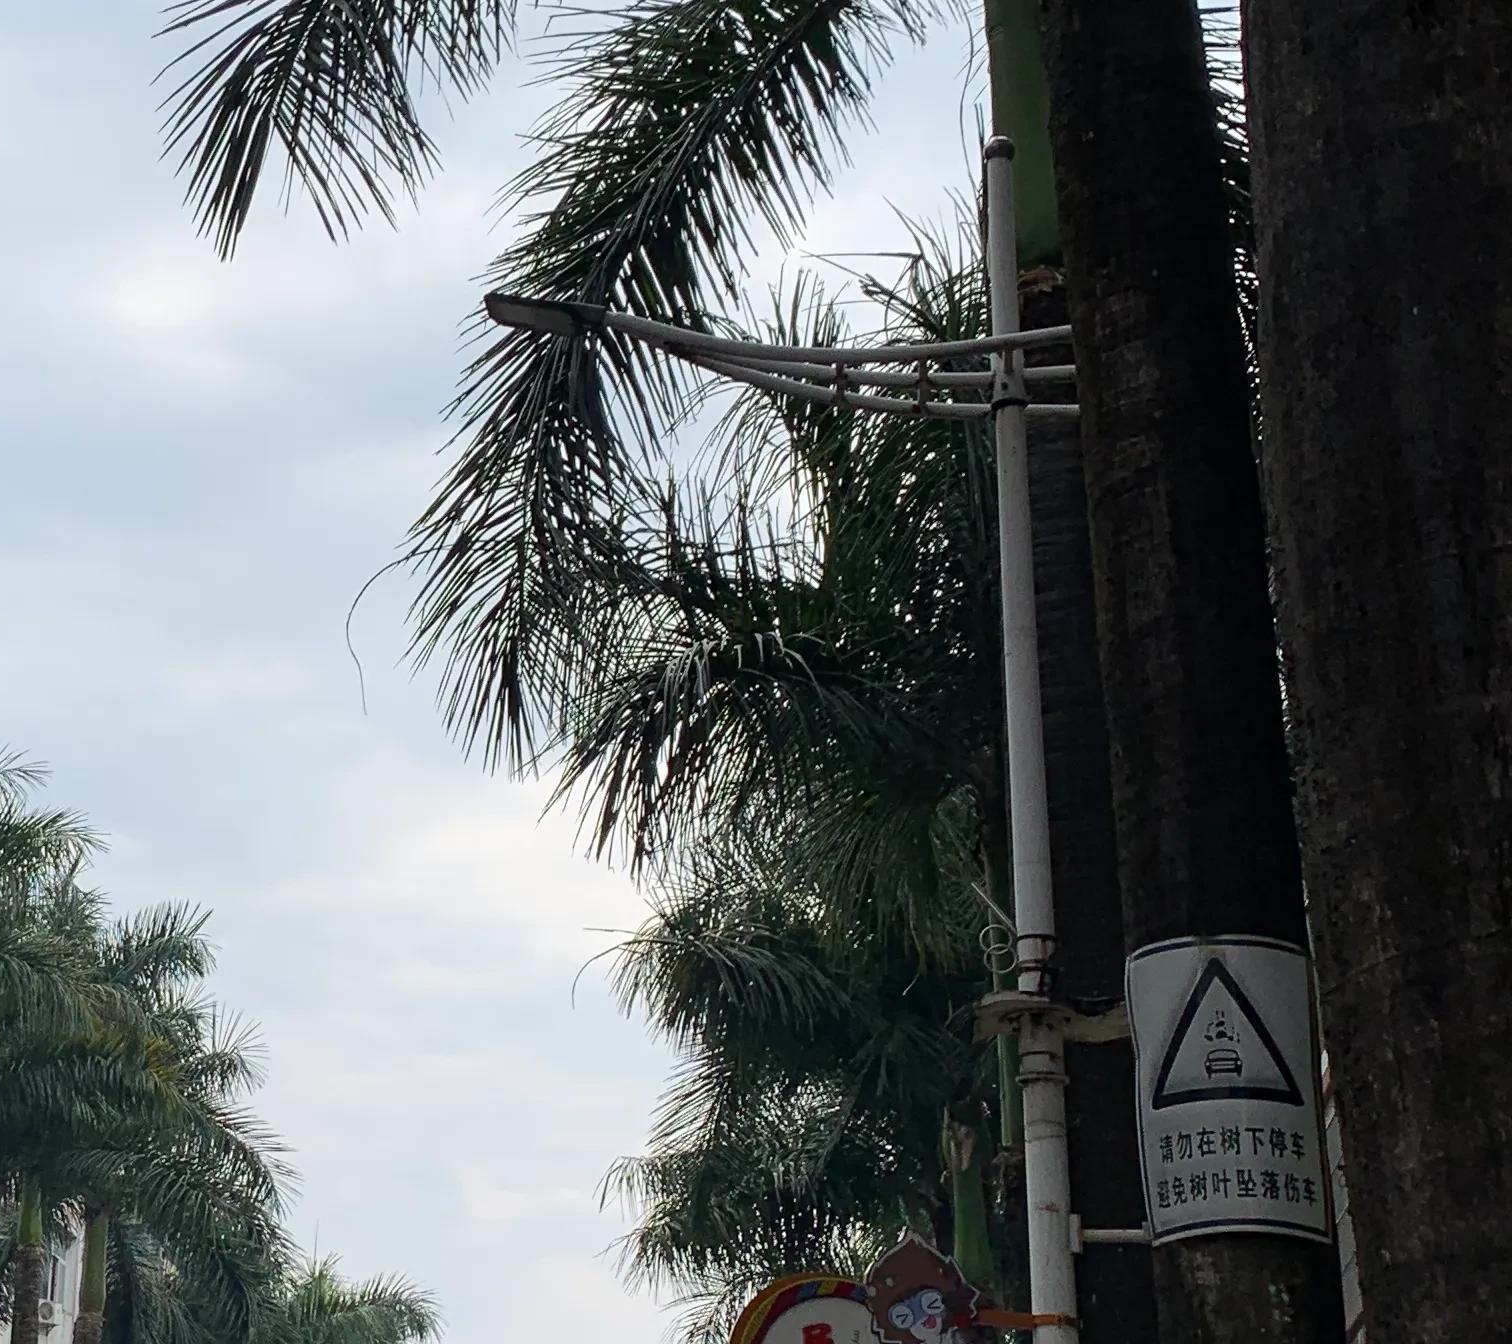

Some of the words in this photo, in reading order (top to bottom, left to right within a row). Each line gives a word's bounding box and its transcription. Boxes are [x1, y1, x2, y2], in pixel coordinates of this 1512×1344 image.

[1159, 1126, 1306, 1164] 请勿在树下停车
[1157, 1169, 1319, 1208] 避免树叶坠落伤车
